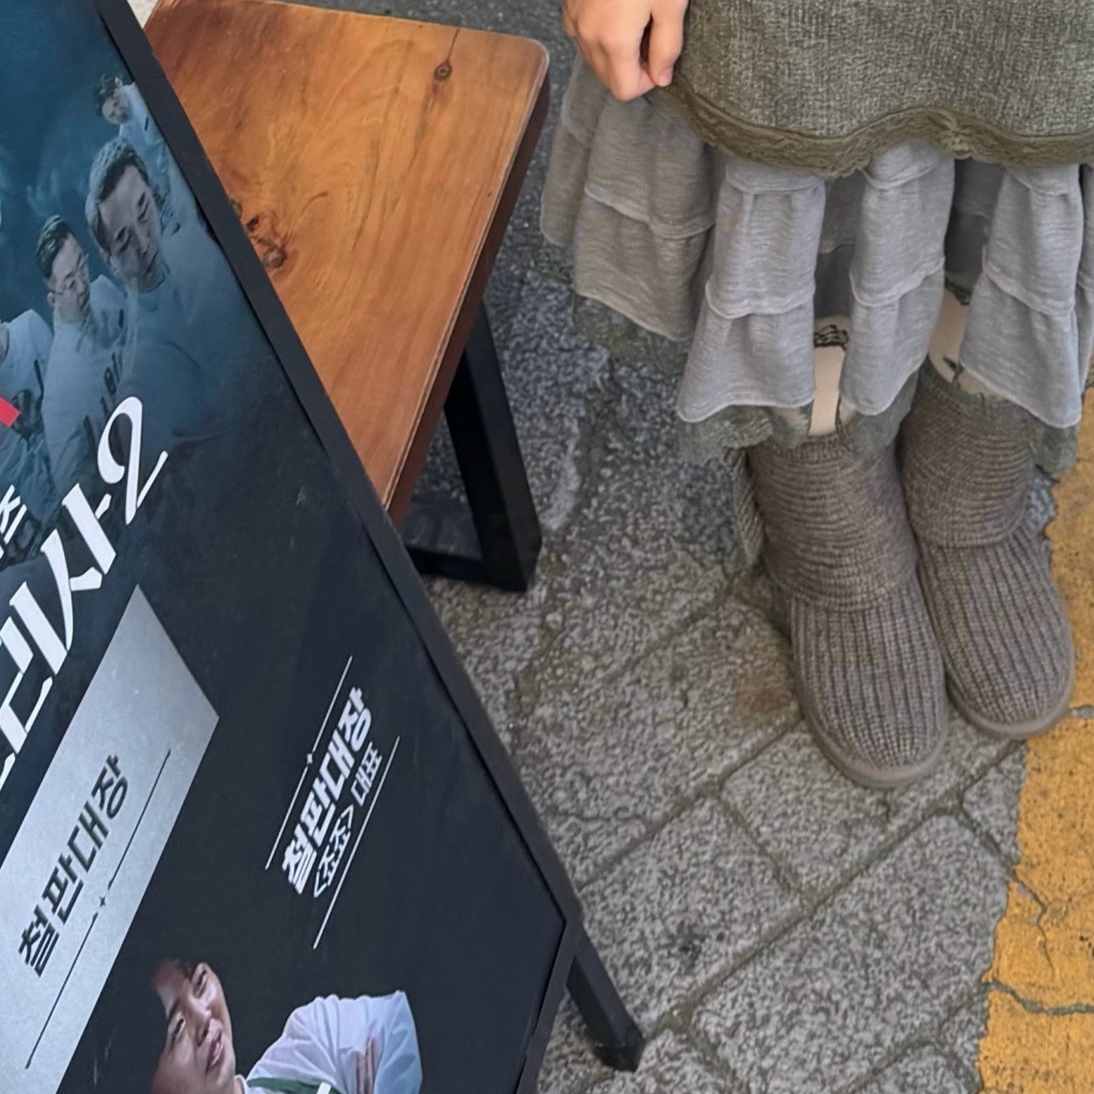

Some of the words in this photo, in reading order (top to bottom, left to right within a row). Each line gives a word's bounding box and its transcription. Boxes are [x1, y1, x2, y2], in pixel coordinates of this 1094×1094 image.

[0, 396, 168, 786] 리사2
[18, 755, 128, 978] 철판대장
[282, 687, 371, 894] 철판대장
[351, 741, 382, 806] 대표
